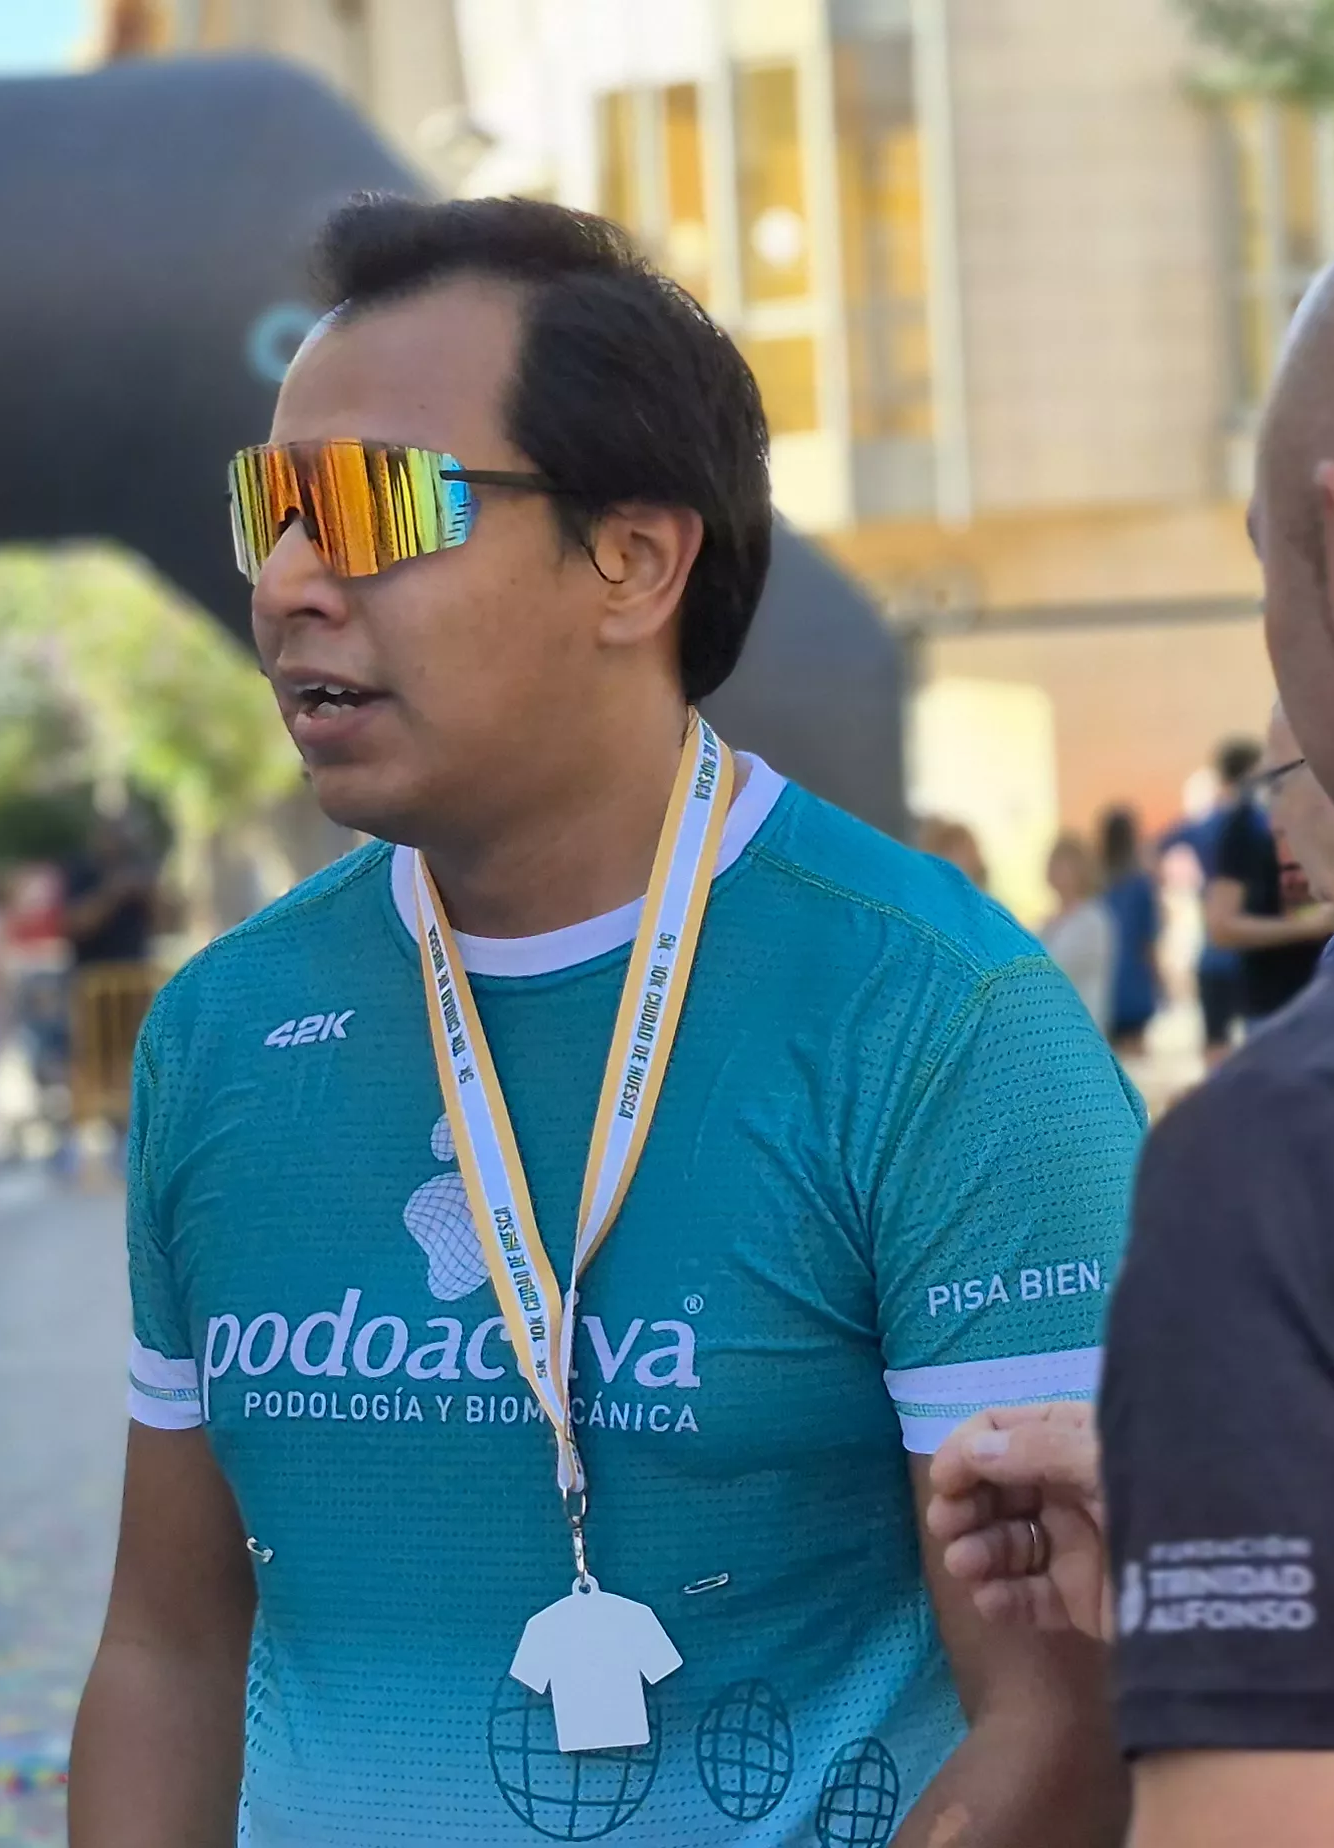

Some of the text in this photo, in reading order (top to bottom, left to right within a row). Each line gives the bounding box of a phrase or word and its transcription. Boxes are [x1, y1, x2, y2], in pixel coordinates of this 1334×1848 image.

[264, 1009, 356, 1048] 42K
[636, 992, 663, 1043] CIUDAD
[631, 1044, 651, 1065] DE
[618, 1064, 646, 1121] HUESCA
[927, 1273, 1010, 1318] PISA
[244, 1386, 700, 1433] PODOLOGÍA Y BIOMCÁNICA
[1146, 1600, 1318, 1633] ALFONSO
